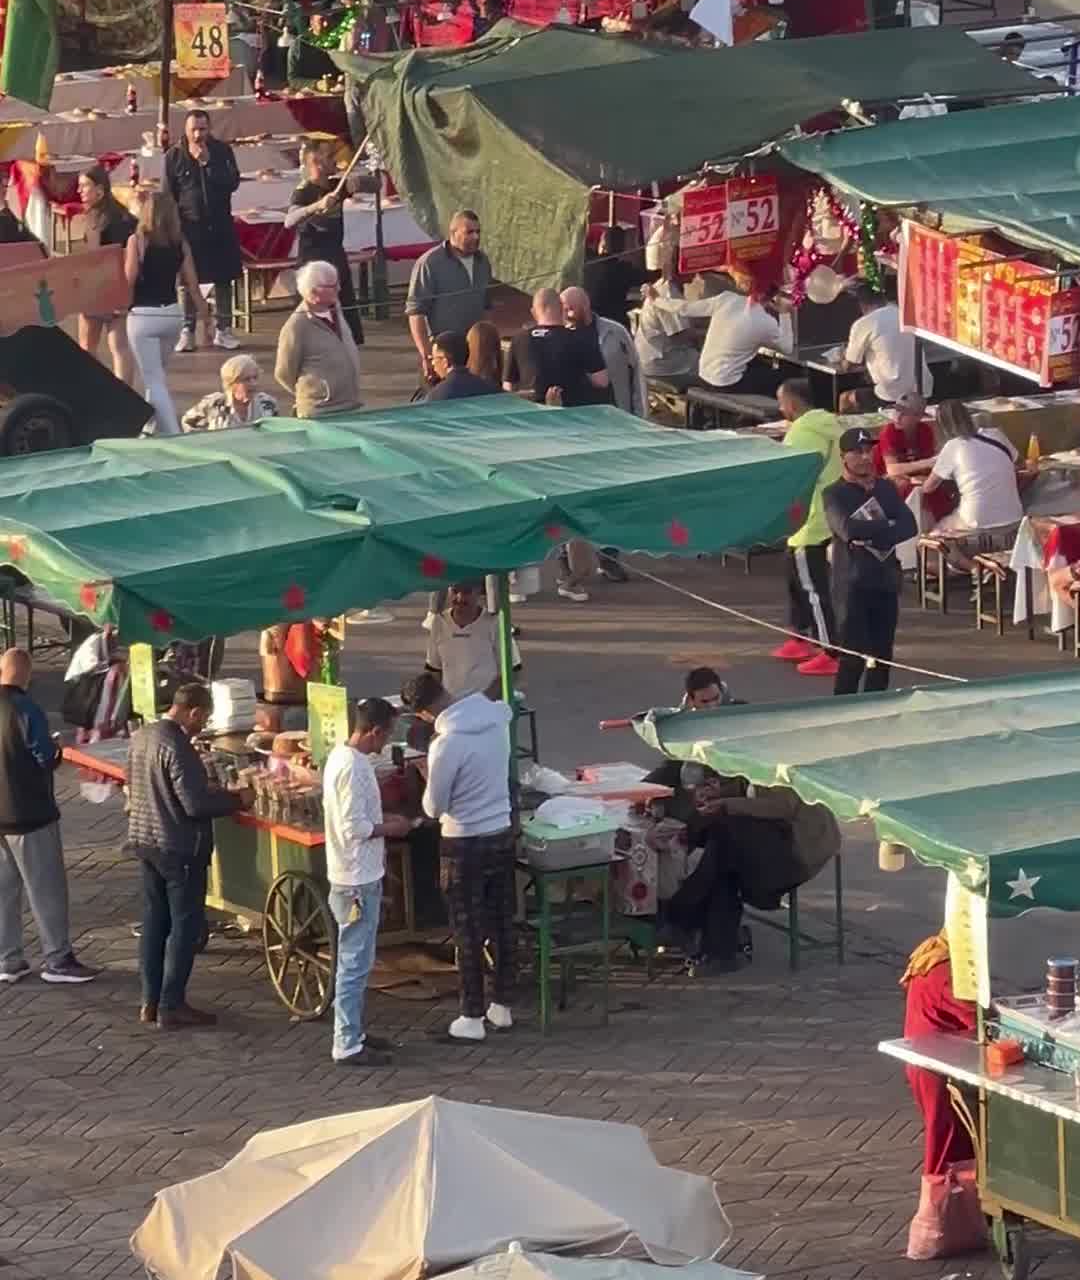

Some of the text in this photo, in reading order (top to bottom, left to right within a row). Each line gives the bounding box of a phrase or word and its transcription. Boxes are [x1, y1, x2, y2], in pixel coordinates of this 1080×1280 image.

[192, 25, 223, 58] 48
[698, 214, 726, 243] 52
[746, 198, 775, 232] 52
